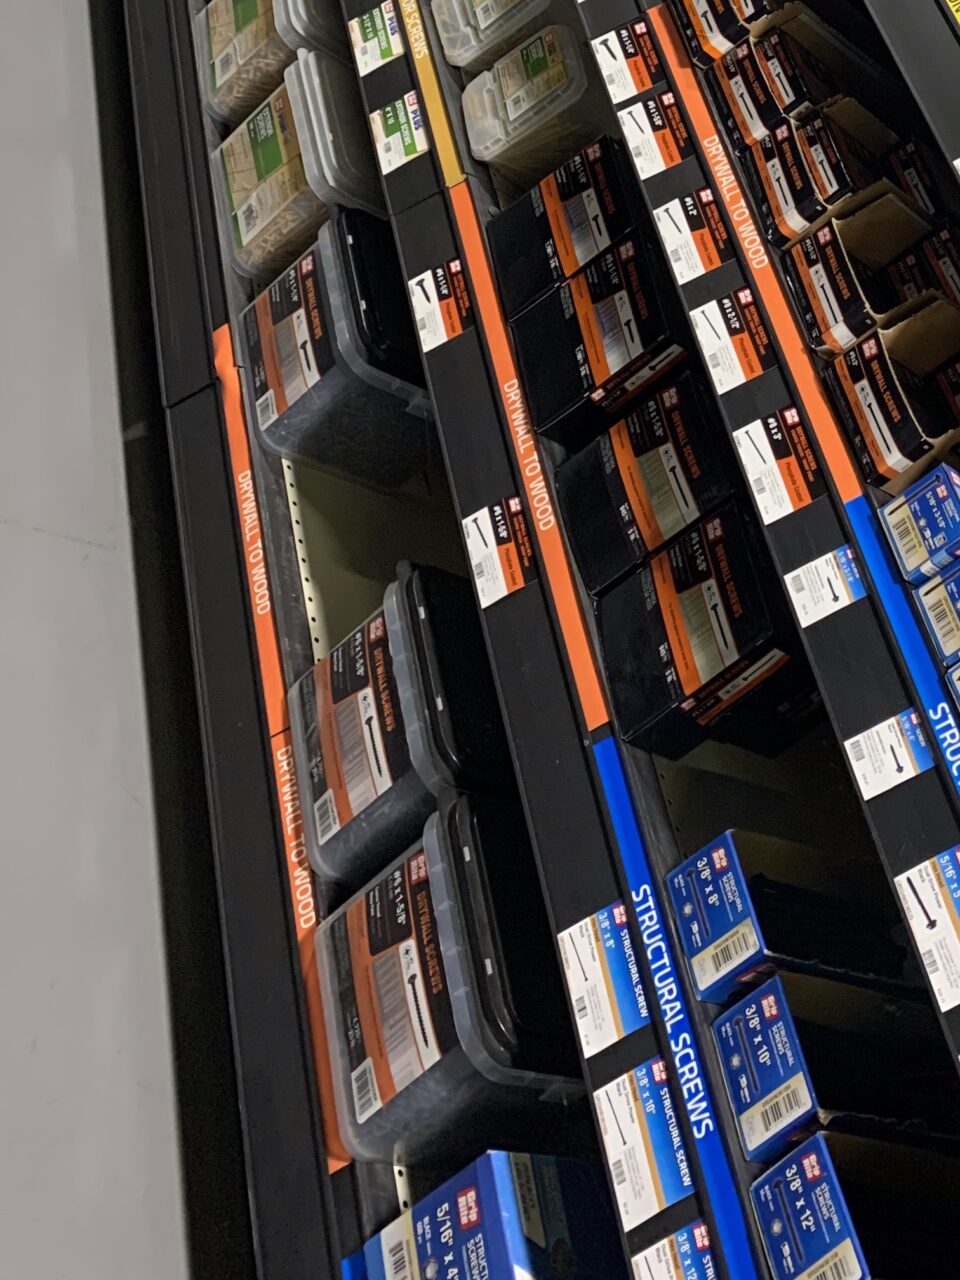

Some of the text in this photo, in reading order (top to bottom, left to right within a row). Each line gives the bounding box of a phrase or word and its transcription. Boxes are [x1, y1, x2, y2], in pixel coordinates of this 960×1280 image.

[404, 11, 429, 59] SCREWS
[699, 132, 770, 271] DRYWALL TO WOOD
[822, 244, 853, 301] DRYWALL SCREWS
[501, 378, 556, 532] DRYWALL TO WOOD
[236, 469, 271, 615] DRYWALL TO WOOD
[275, 744, 317, 929] DRYWALL TO WOOD
[627, 882, 715, 1140] STRUCTURAL SCREWS
[744, 1003, 772, 1068] 3/8" x 10"
